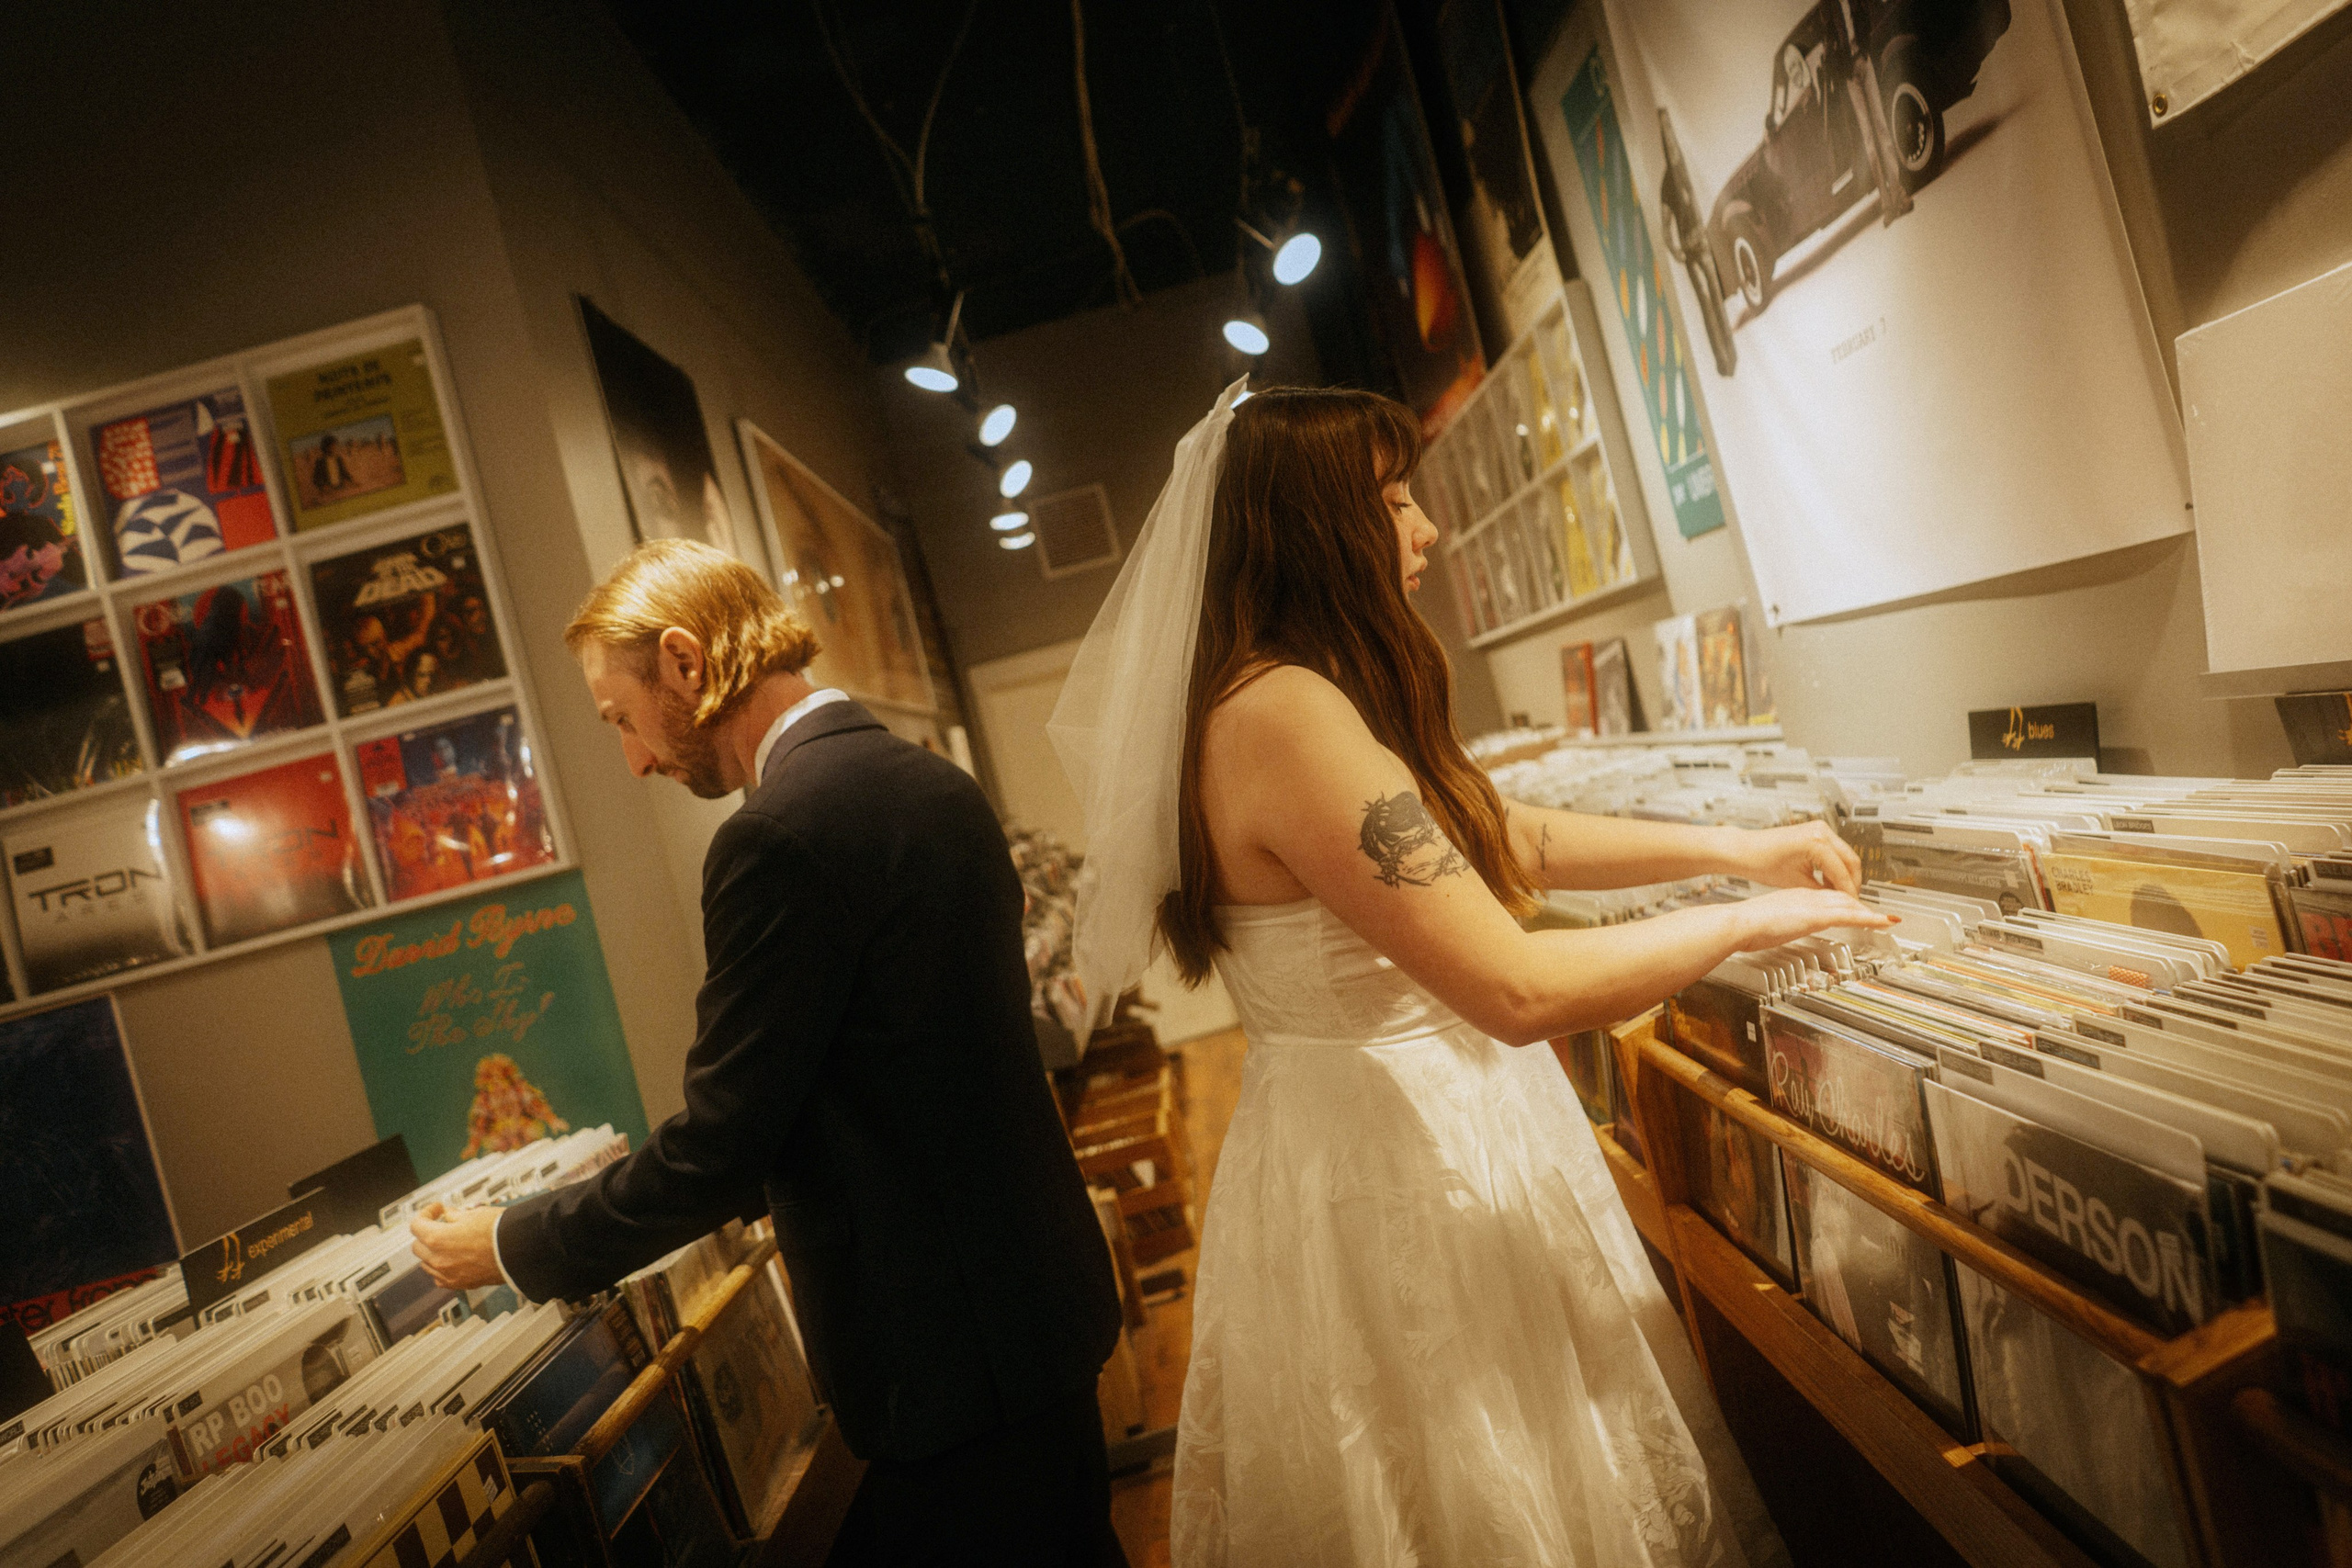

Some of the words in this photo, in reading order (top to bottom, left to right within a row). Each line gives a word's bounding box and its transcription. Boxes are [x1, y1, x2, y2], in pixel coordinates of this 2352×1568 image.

[1831, 323, 1875, 365] FEBRUARY
[354, 565, 447, 608] DEAD
[2028, 720, 2055, 740] blues
[28, 867, 163, 913] TRON
[2051, 864, 2092, 884] CHARLES
[2055, 879, 2095, 897] BRADLEY
[351, 919, 463, 978] David
[466, 902, 577, 960] Byrne
[419, 973, 483, 1017] Who
[488, 961, 530, 999] Is
[405, 1012, 468, 1055] The
[473, 990, 556, 1043] Sky!
[1770, 1050, 1815, 1130] Ray
[1815, 1072, 1927, 1183] Charles
[247, 1209, 314, 1259] experimental
[2001, 1141, 2205, 1330] DERSON
[187, 1409, 225, 1459] RP
[228, 1373, 285, 1430] BOO
